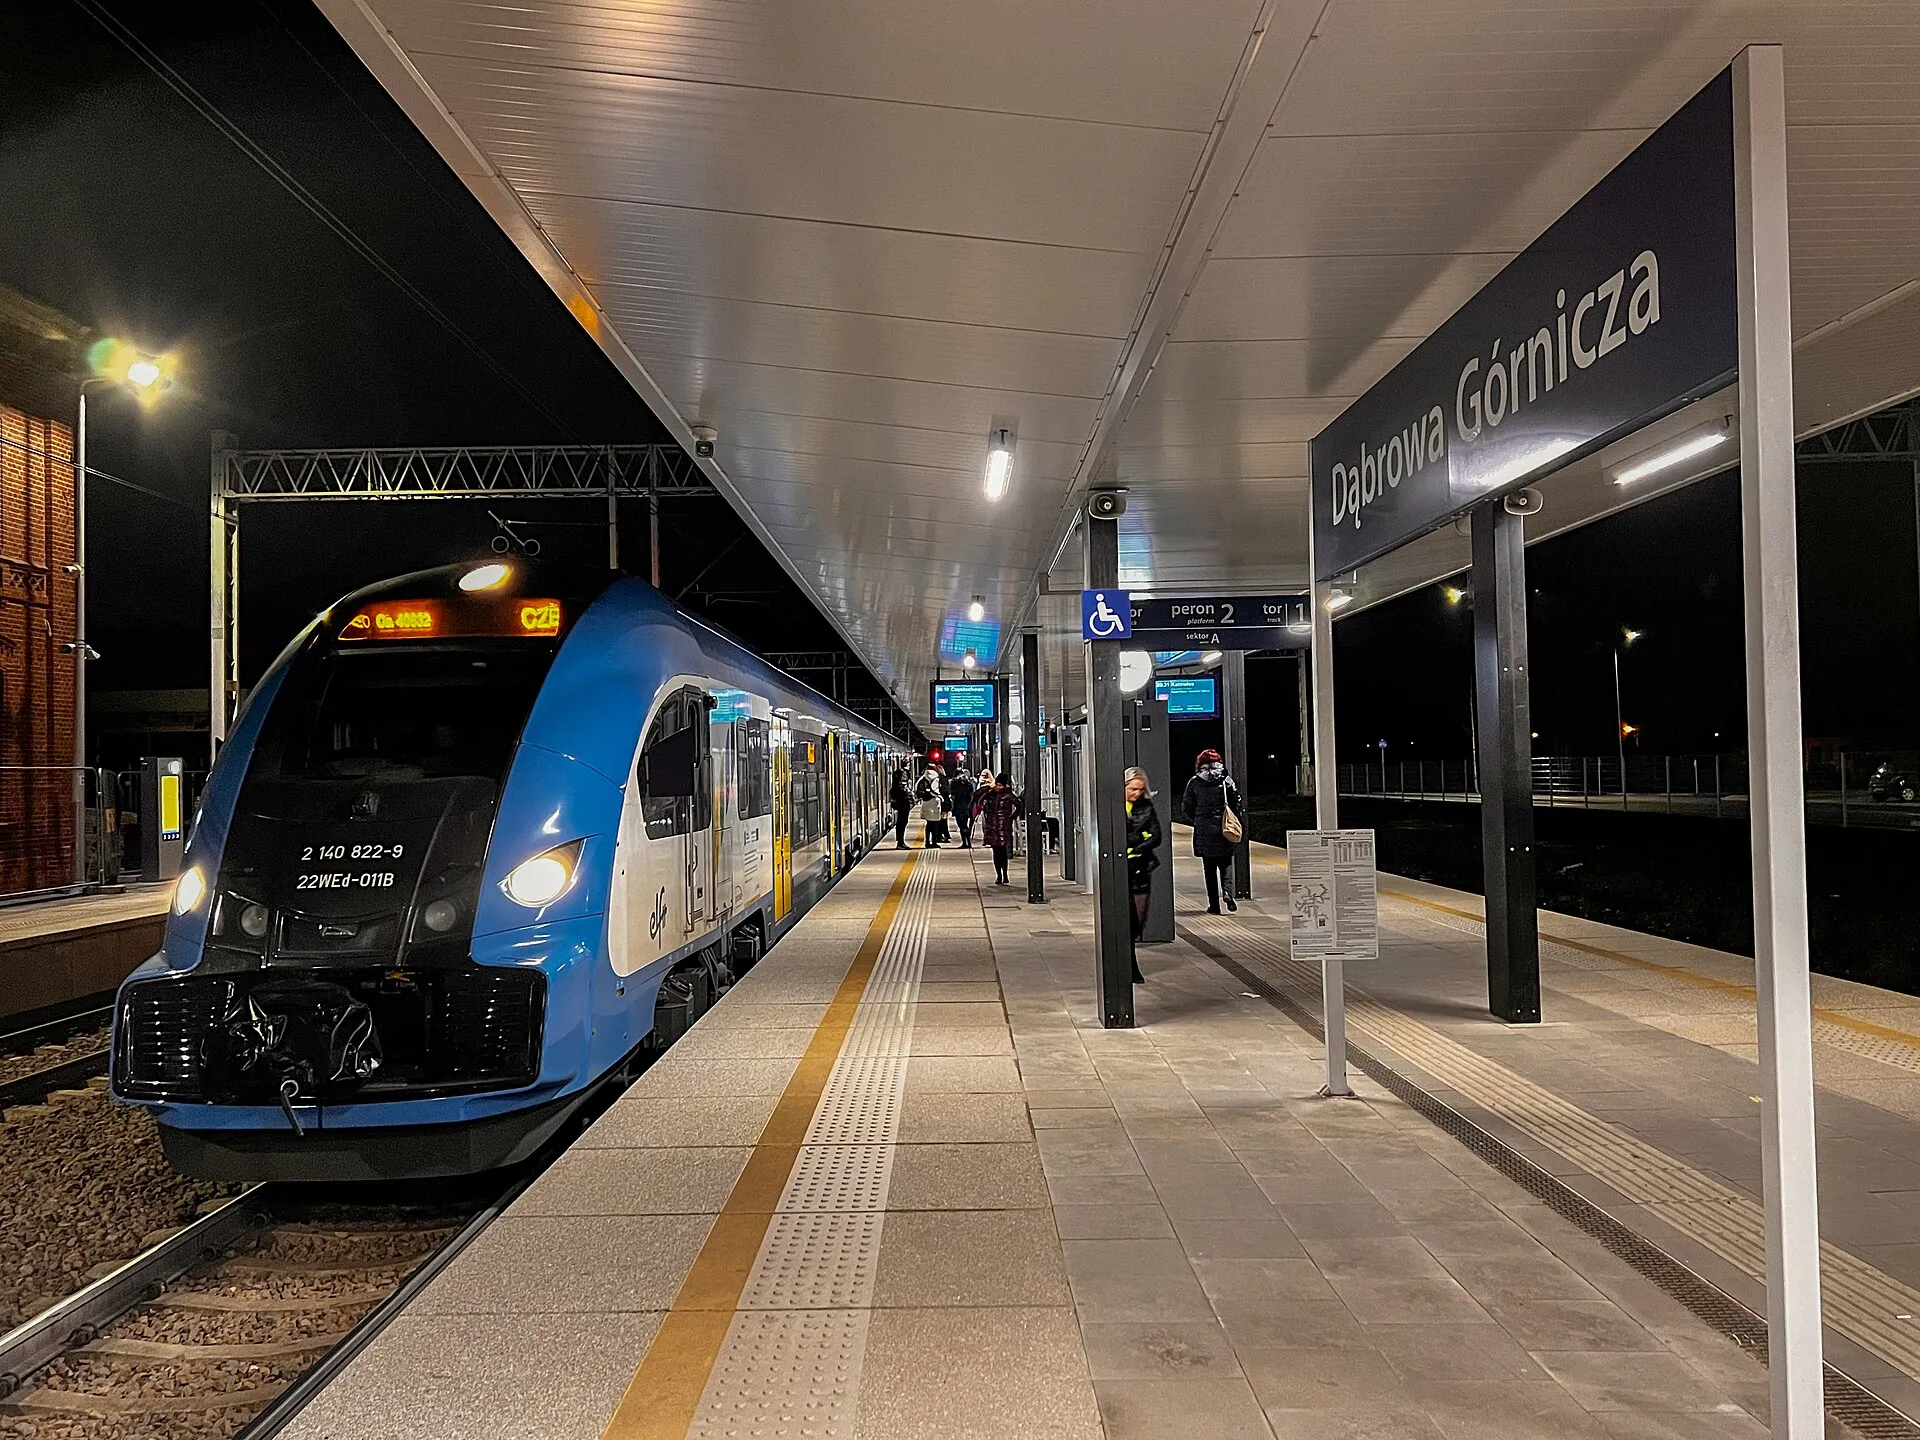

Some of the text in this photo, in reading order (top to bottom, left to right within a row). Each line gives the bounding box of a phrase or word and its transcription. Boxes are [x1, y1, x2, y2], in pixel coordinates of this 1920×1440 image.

[1331, 248, 1662, 531] Dąbrowa Górnicza
[1130, 608, 1143, 618] or
[1171, 603, 1235, 624] peron 2
[1187, 617, 1215, 625] platform
[1262, 603, 1304, 622] tor 1
[1210, 633, 1220, 644] A
[301, 844, 404, 861] 2 140 822-9
[296, 872, 395, 890] 22WEd-011B
